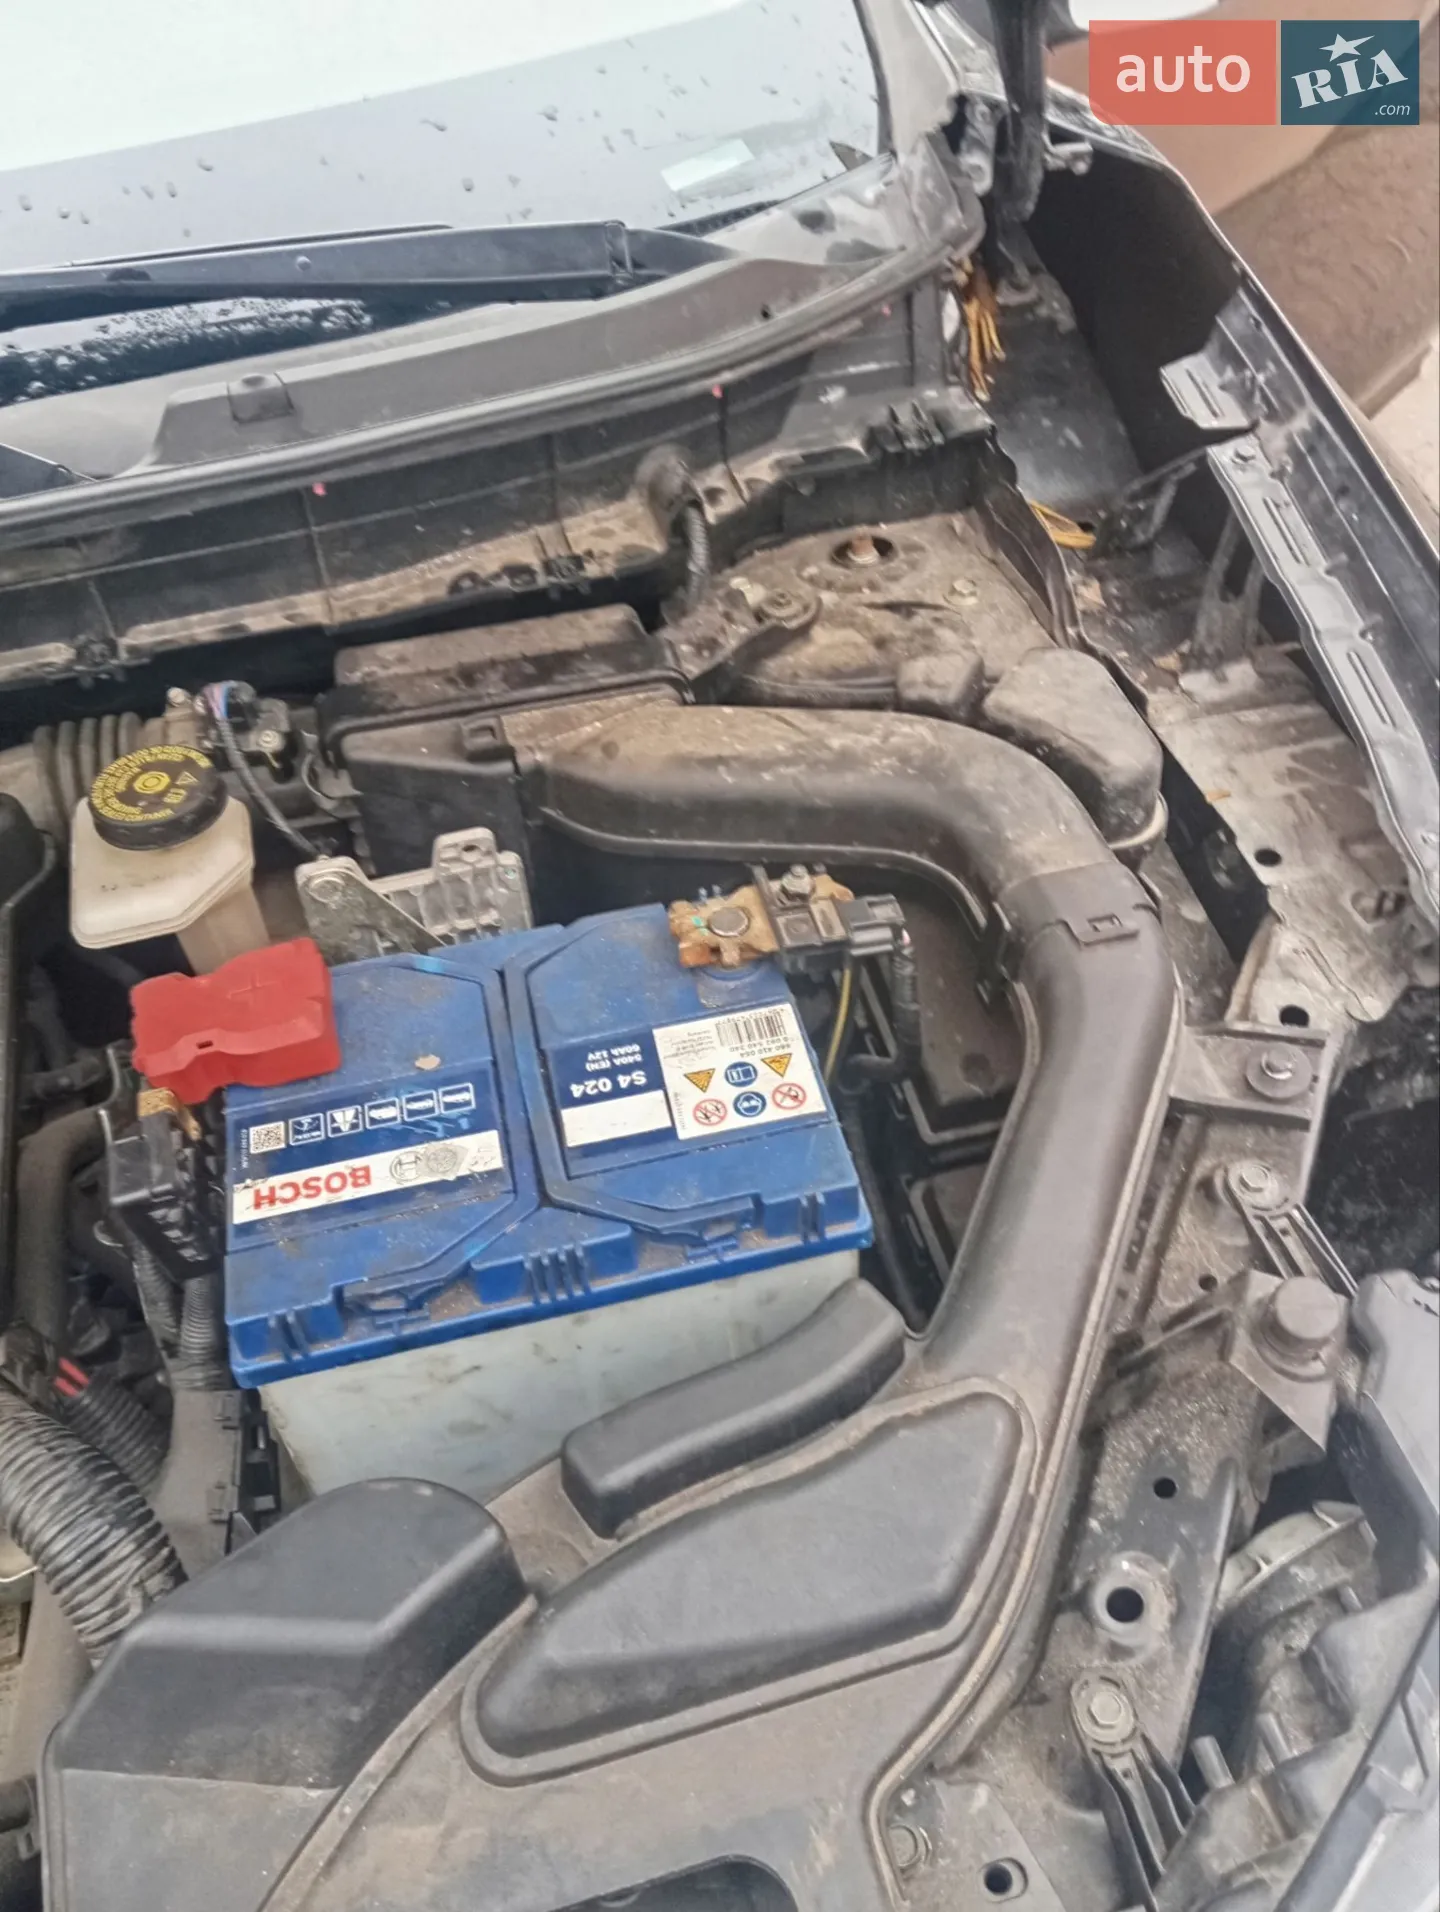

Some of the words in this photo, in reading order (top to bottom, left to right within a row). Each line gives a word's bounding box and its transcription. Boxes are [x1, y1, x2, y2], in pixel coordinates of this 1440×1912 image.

[587, 1050, 609, 1061] 12V
[610, 1043, 641, 1056] 60Ah
[585, 1061, 612, 1072] (EN)
[612, 1054, 643, 1066] 540A
[617, 1070, 648, 1089] S4
[569, 1077, 612, 1098] 024
[253, 1165, 371, 1210] BOSCH
